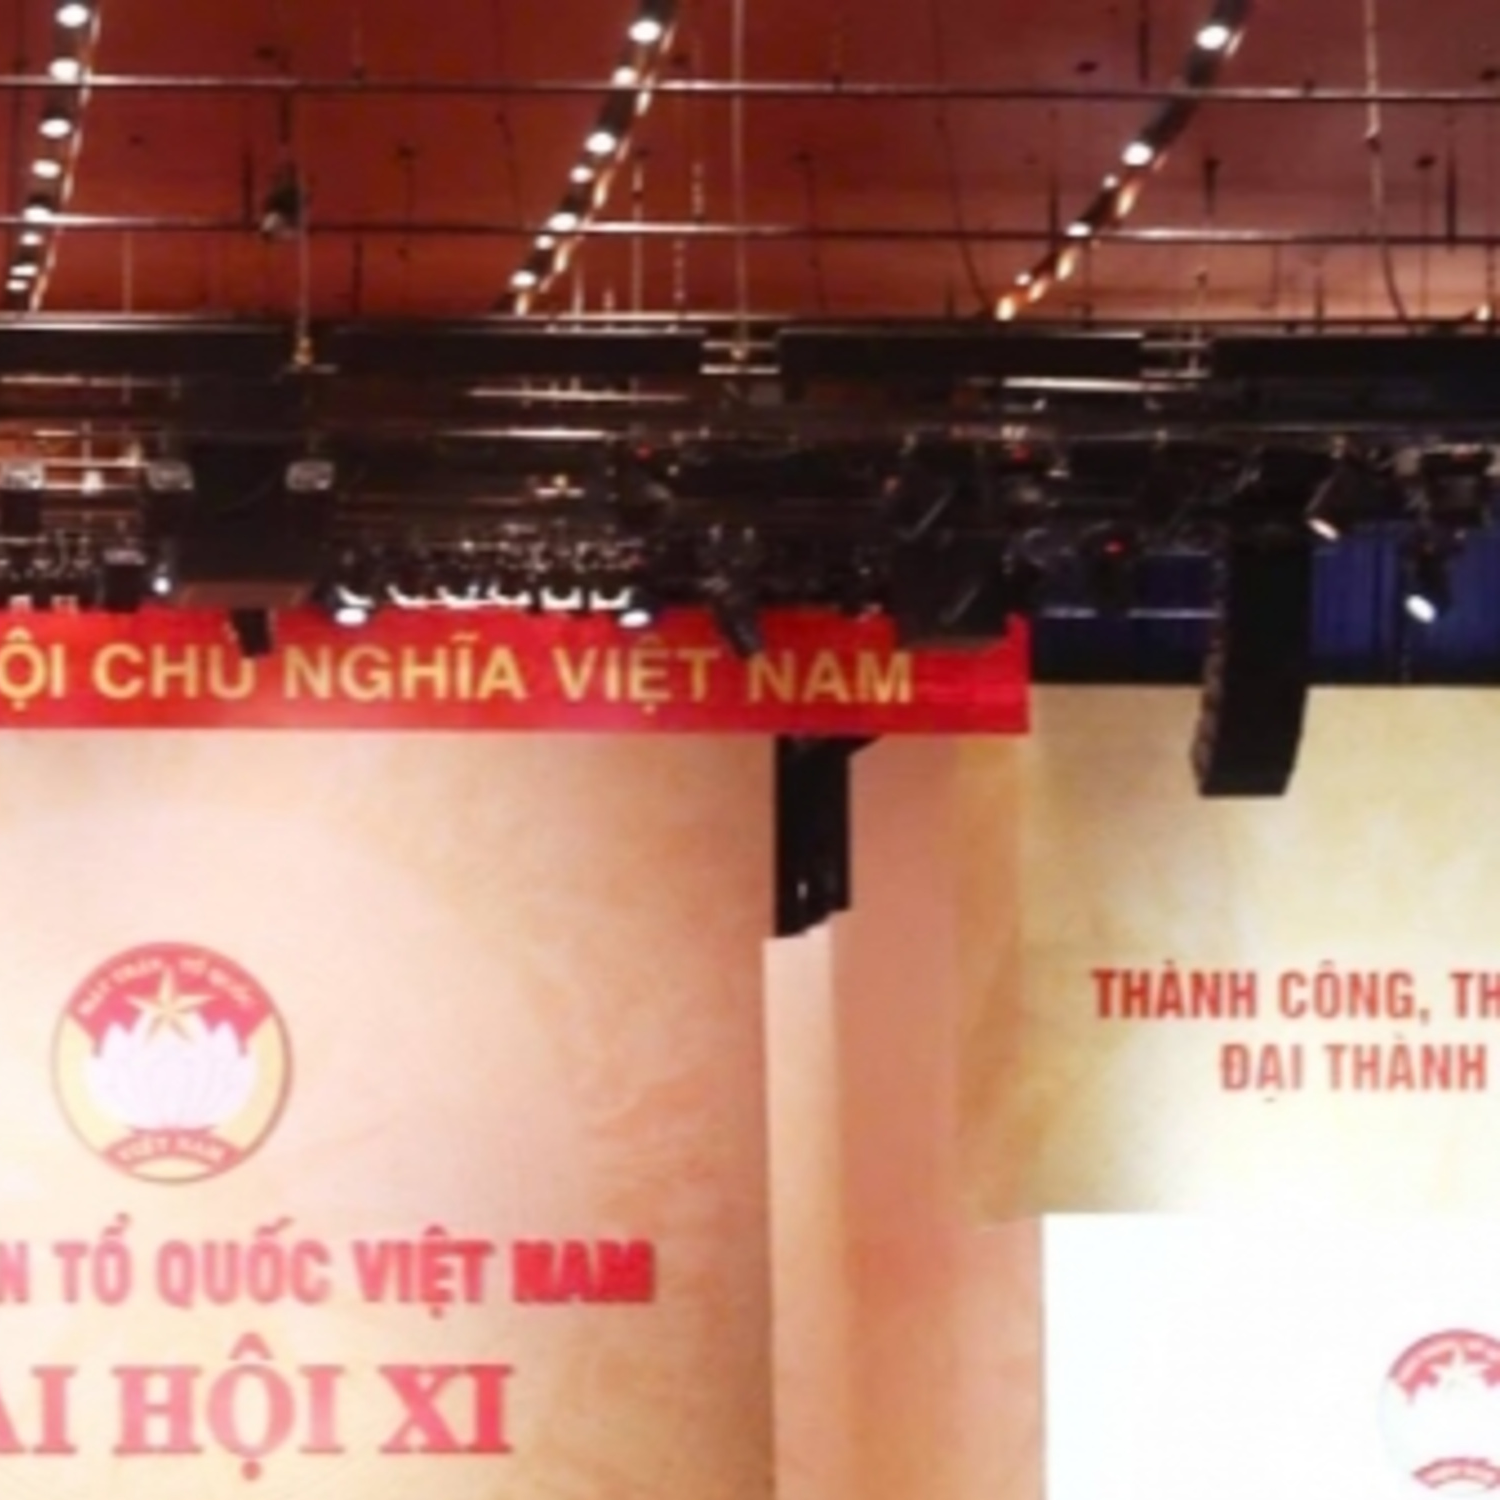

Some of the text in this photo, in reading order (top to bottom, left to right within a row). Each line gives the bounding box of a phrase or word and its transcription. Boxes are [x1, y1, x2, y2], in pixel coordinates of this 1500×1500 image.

[284, 631, 530, 702] NGHĨA
[552, 633, 722, 715] VIỆT
[749, 650, 913, 703] NAM
[1091, 958, 1258, 1019] THÀNH
[1279, 959, 1430, 1026] CÔNG,
[1219, 1033, 1487, 1102] ĐẠI THÀNH
[53, 1211, 133, 1307] TỔ
[156, 1216, 333, 1310] QUỐC
[352, 1225, 496, 1320] VIỆT
[512, 1239, 657, 1305] NAM
[111, 1331, 346, 1482] HỘI
[378, 1364, 515, 1455] XI
